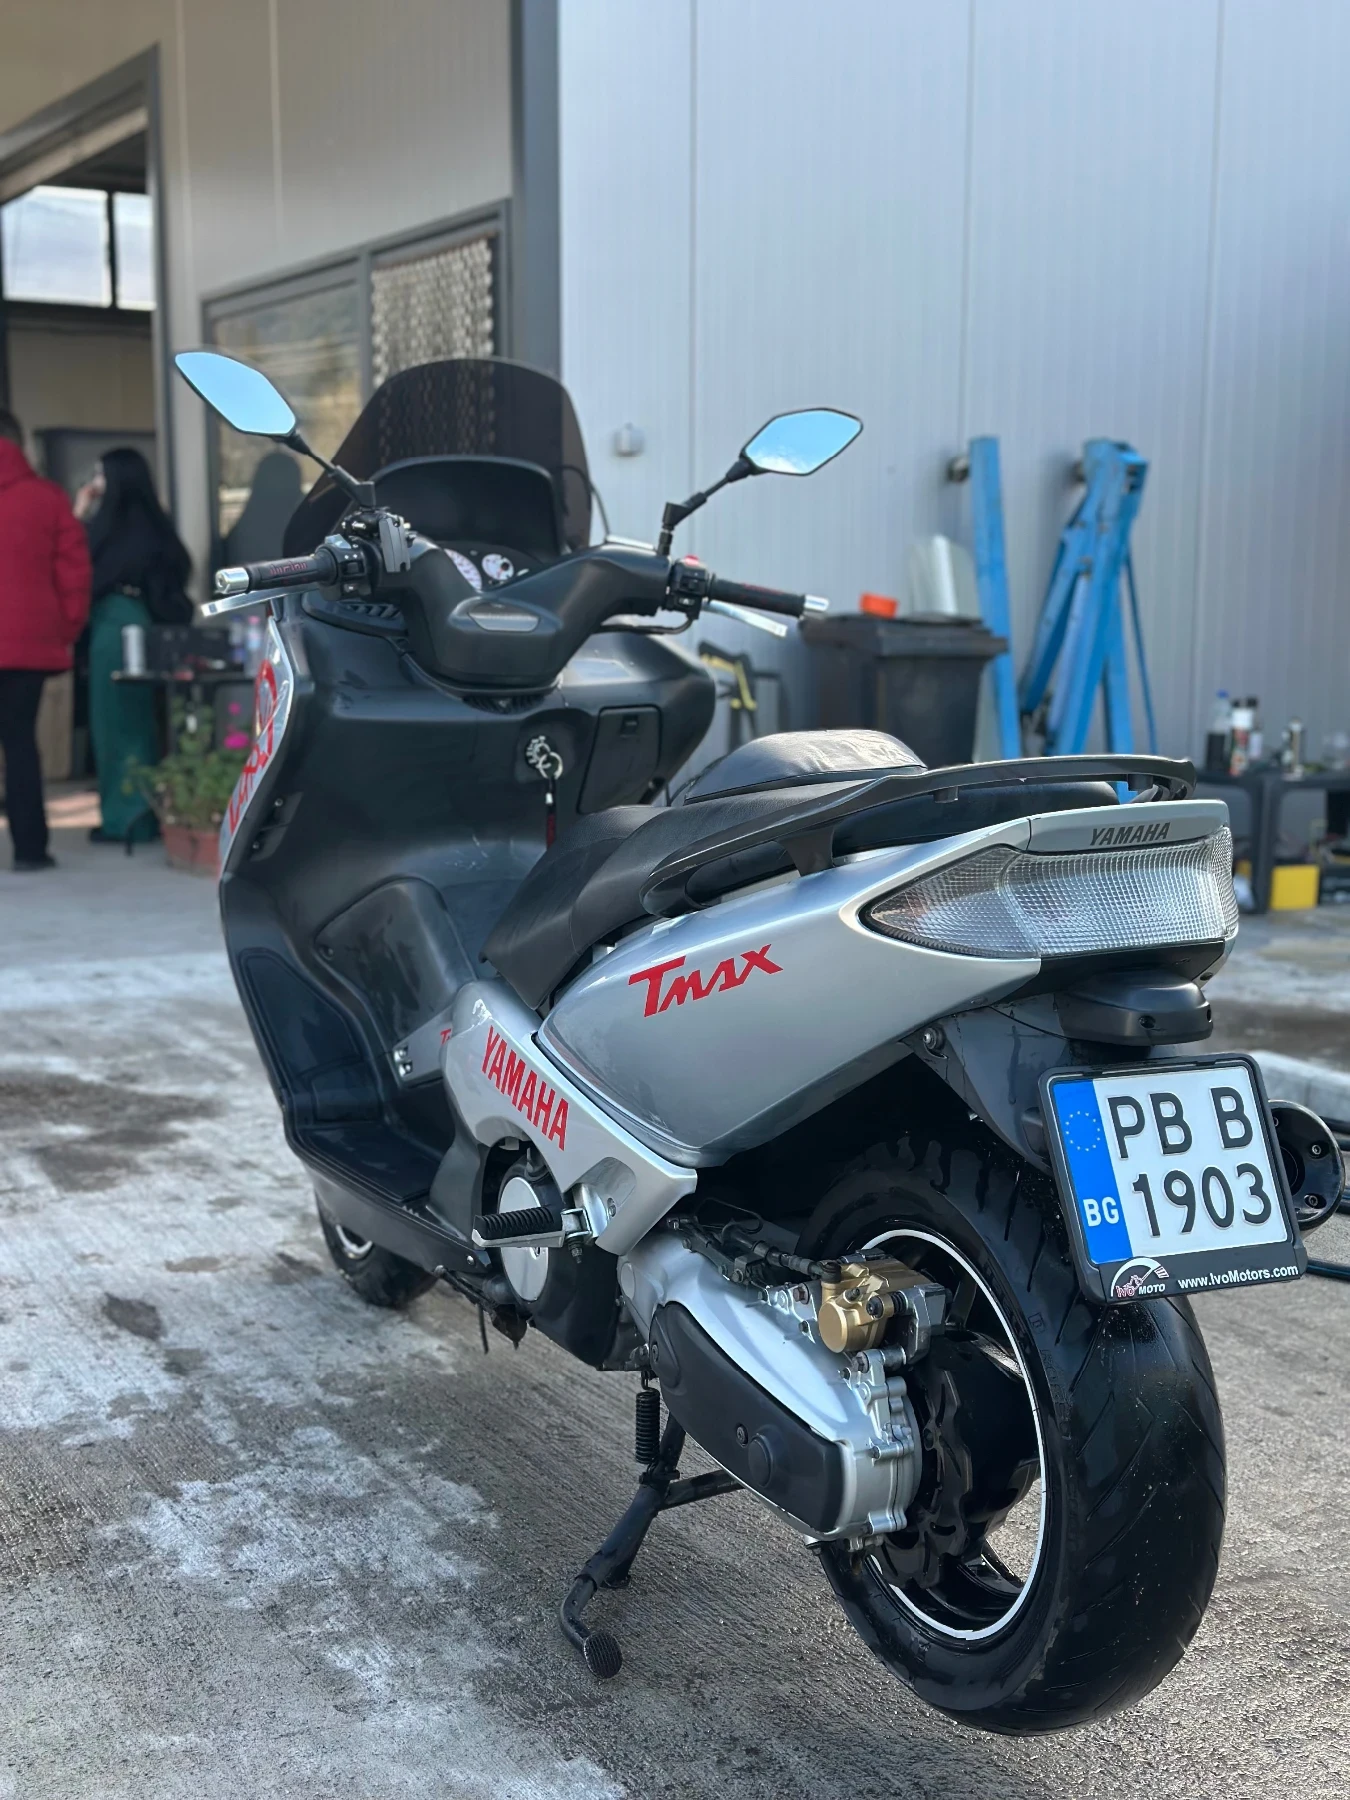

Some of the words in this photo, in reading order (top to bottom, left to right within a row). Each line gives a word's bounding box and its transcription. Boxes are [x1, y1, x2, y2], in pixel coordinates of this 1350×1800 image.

[1089, 822, 1171, 846] YAMAHA
[481, 1025, 570, 1152] YAMAHA
[1106, 1092, 1193, 1159] PB
[1210, 1086, 1253, 1149] B
[1083, 1196, 1120, 1227] BG
[1131, 1162, 1272, 1237] 1903
[1138, 1283, 1166, 1296] MOTO
[1177, 1265, 1299, 1290] www.IvoMotors.com
